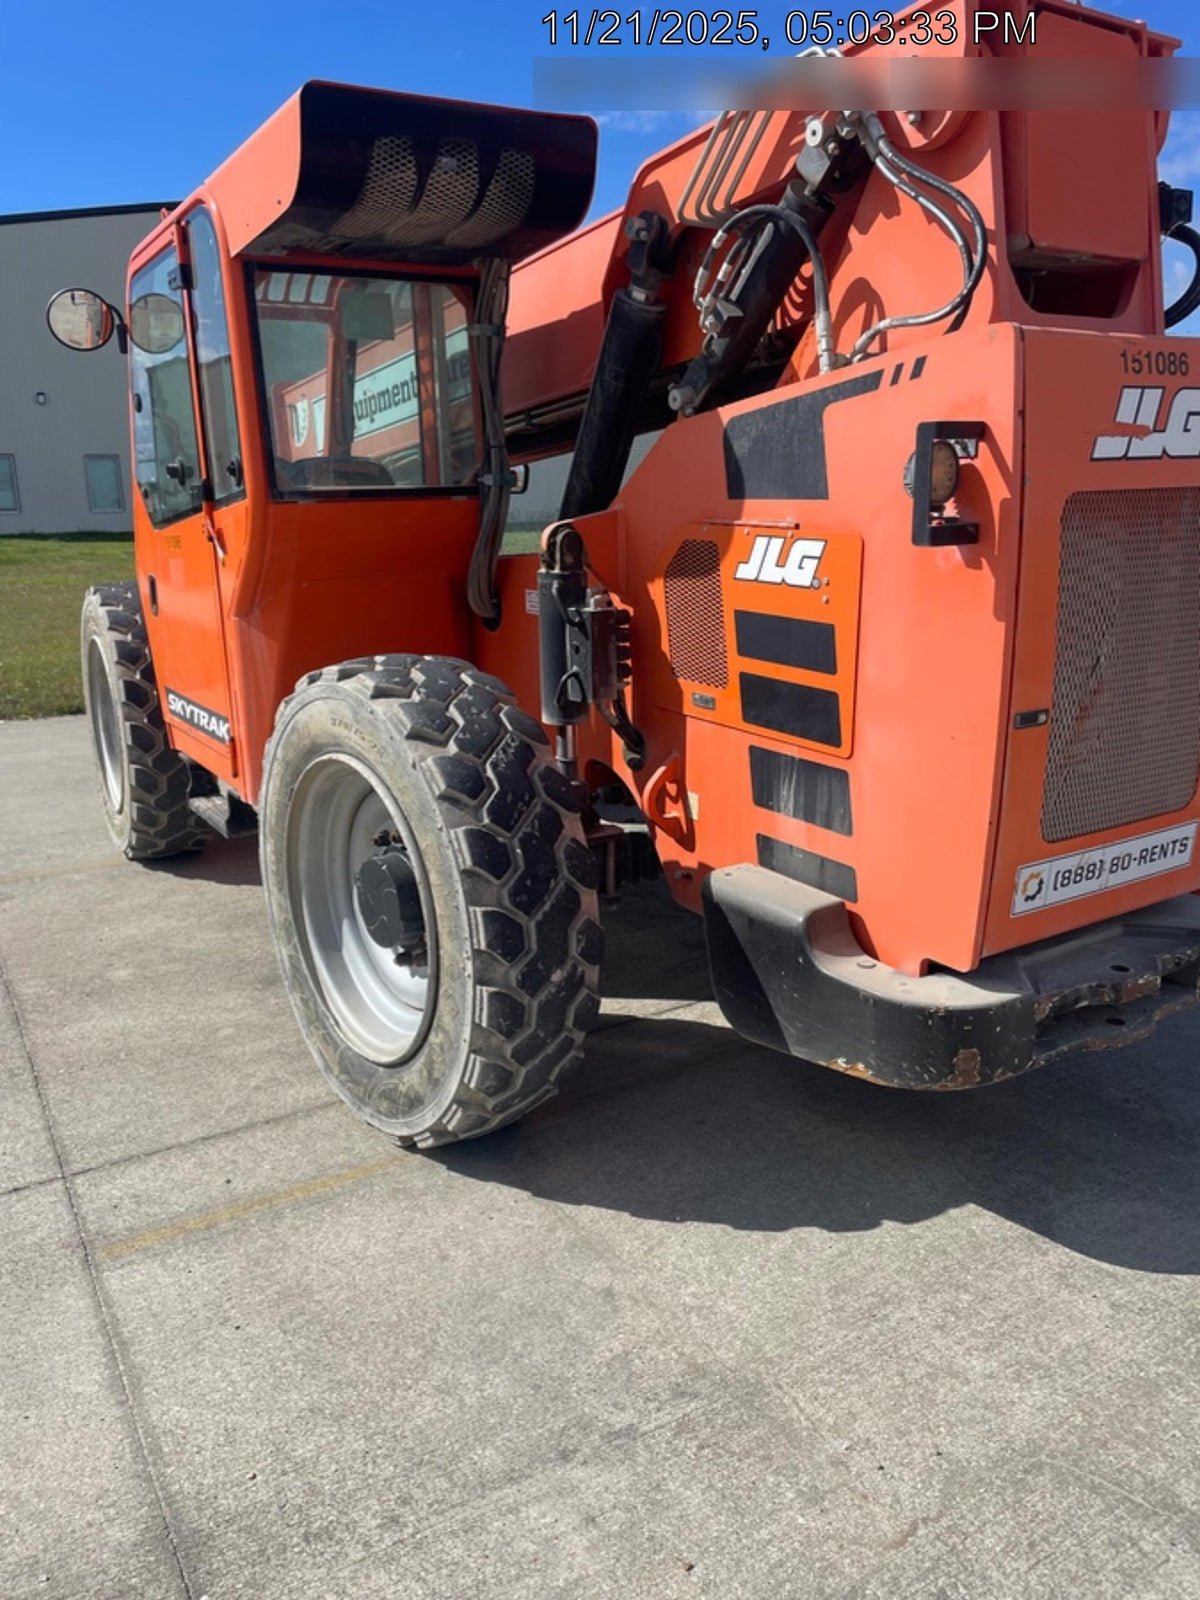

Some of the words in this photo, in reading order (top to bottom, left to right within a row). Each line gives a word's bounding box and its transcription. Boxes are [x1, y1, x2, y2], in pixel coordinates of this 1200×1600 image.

[1120, 349, 1189, 376] 151086
[1090, 385, 1200, 462] JLG
[733, 534, 828, 589] JLG
[168, 693, 230, 742] SKYTRAK
[1052, 860, 1104, 891] (888)
[1109, 837, 1190, 874] 80-RENTS
